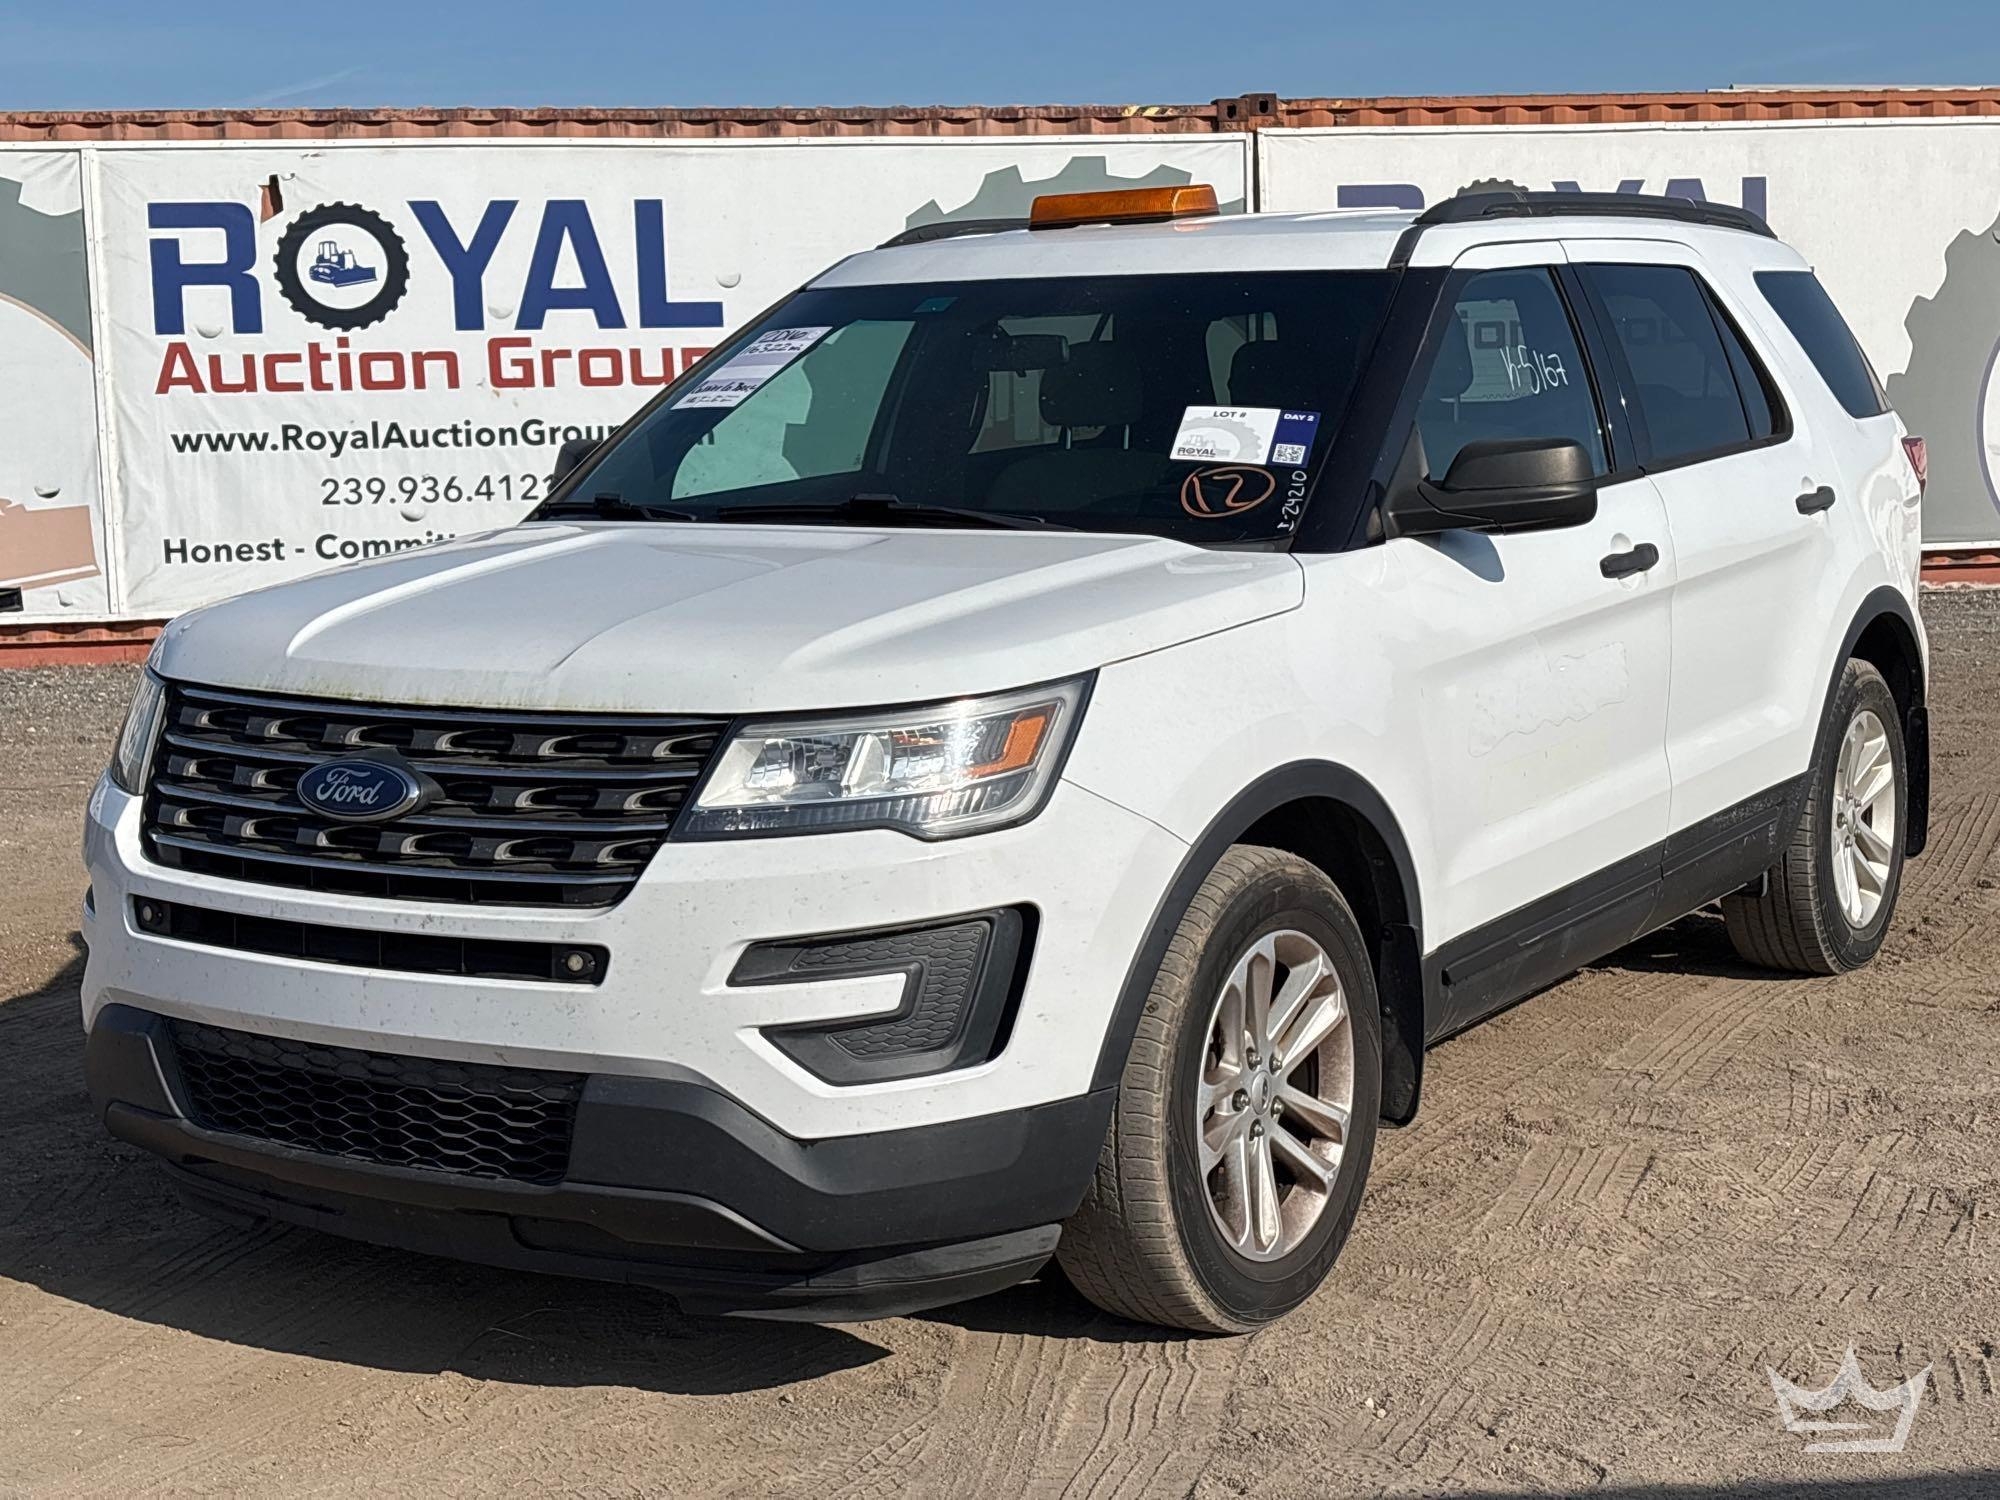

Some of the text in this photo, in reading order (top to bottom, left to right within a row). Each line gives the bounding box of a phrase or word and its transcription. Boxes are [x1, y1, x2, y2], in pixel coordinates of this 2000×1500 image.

[147, 198, 724, 336] ROYAL
[155, 336, 460, 395] Auction
[1213, 410, 1238, 418] LOT
[1283, 413, 1306, 421] DAY
[1177, 446, 1217, 456] ROYAL
[163, 537, 286, 564] Honest
[315, 766, 385, 806] Ford
